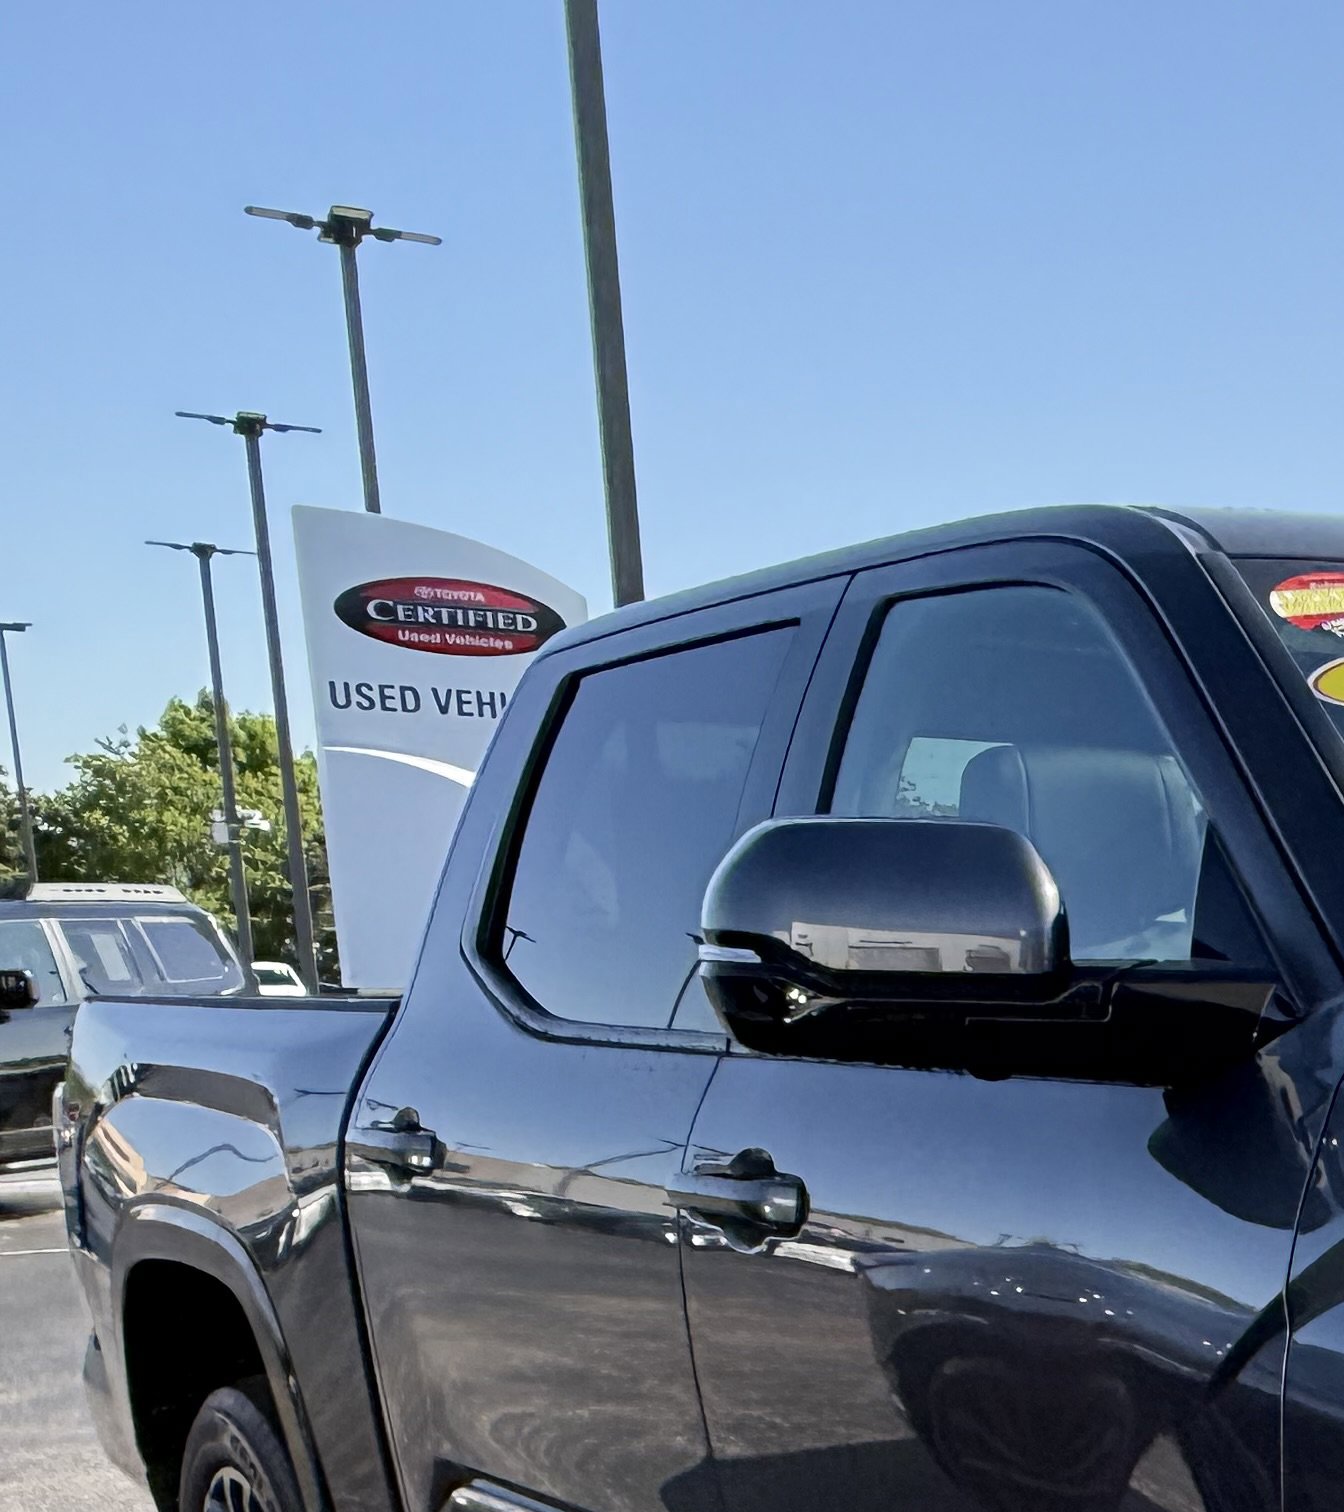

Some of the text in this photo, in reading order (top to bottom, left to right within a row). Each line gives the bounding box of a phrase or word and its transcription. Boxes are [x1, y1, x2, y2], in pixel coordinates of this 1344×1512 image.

[434, 589, 486, 604] TOYOTA
[366, 599, 538, 632] CERTIFIED
[397, 629, 514, 651] Used Vehicles
[328, 680, 507, 719] USED VEHI
